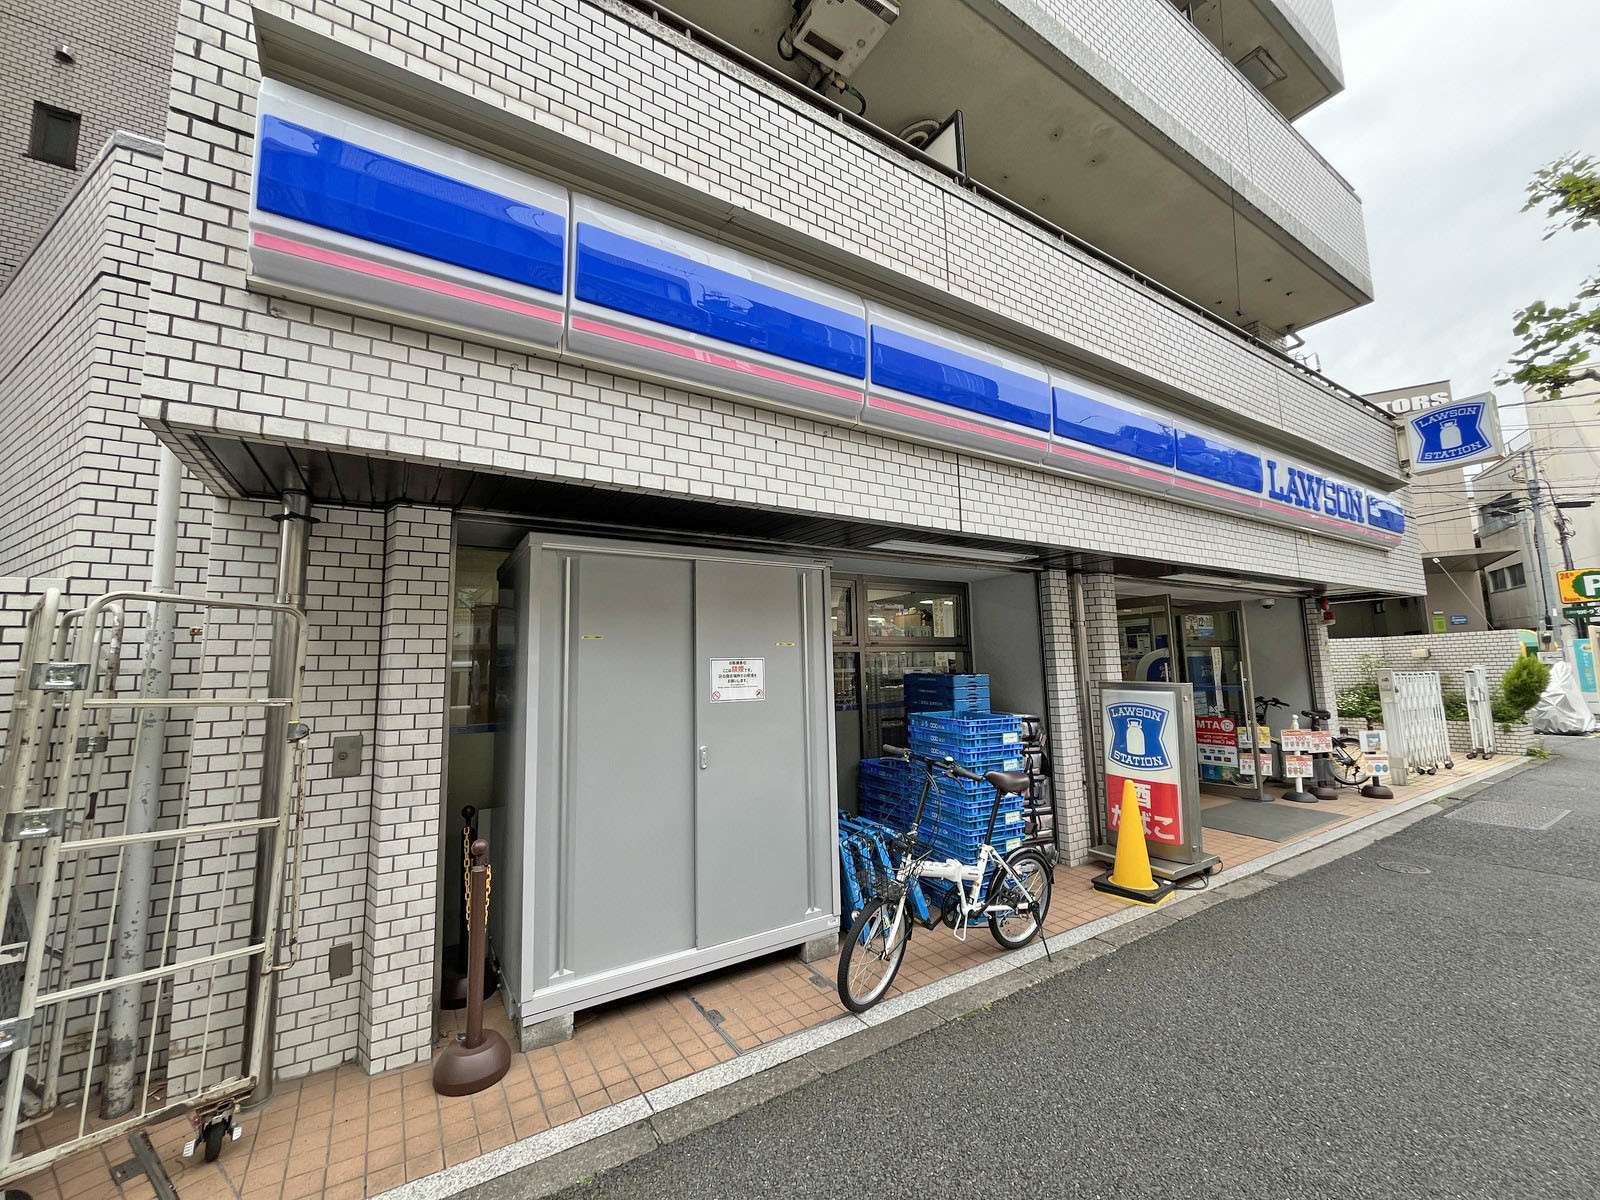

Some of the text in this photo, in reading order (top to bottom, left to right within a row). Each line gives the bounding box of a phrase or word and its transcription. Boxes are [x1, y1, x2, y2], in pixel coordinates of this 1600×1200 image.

[1417, 405, 1479, 429] LAWSON
[1424, 440, 1482, 460] STATION
[1266, 459, 1365, 524] LAWSON
[1110, 706, 1162, 722] LAWSON
[1113, 750, 1163, 767] STATION
